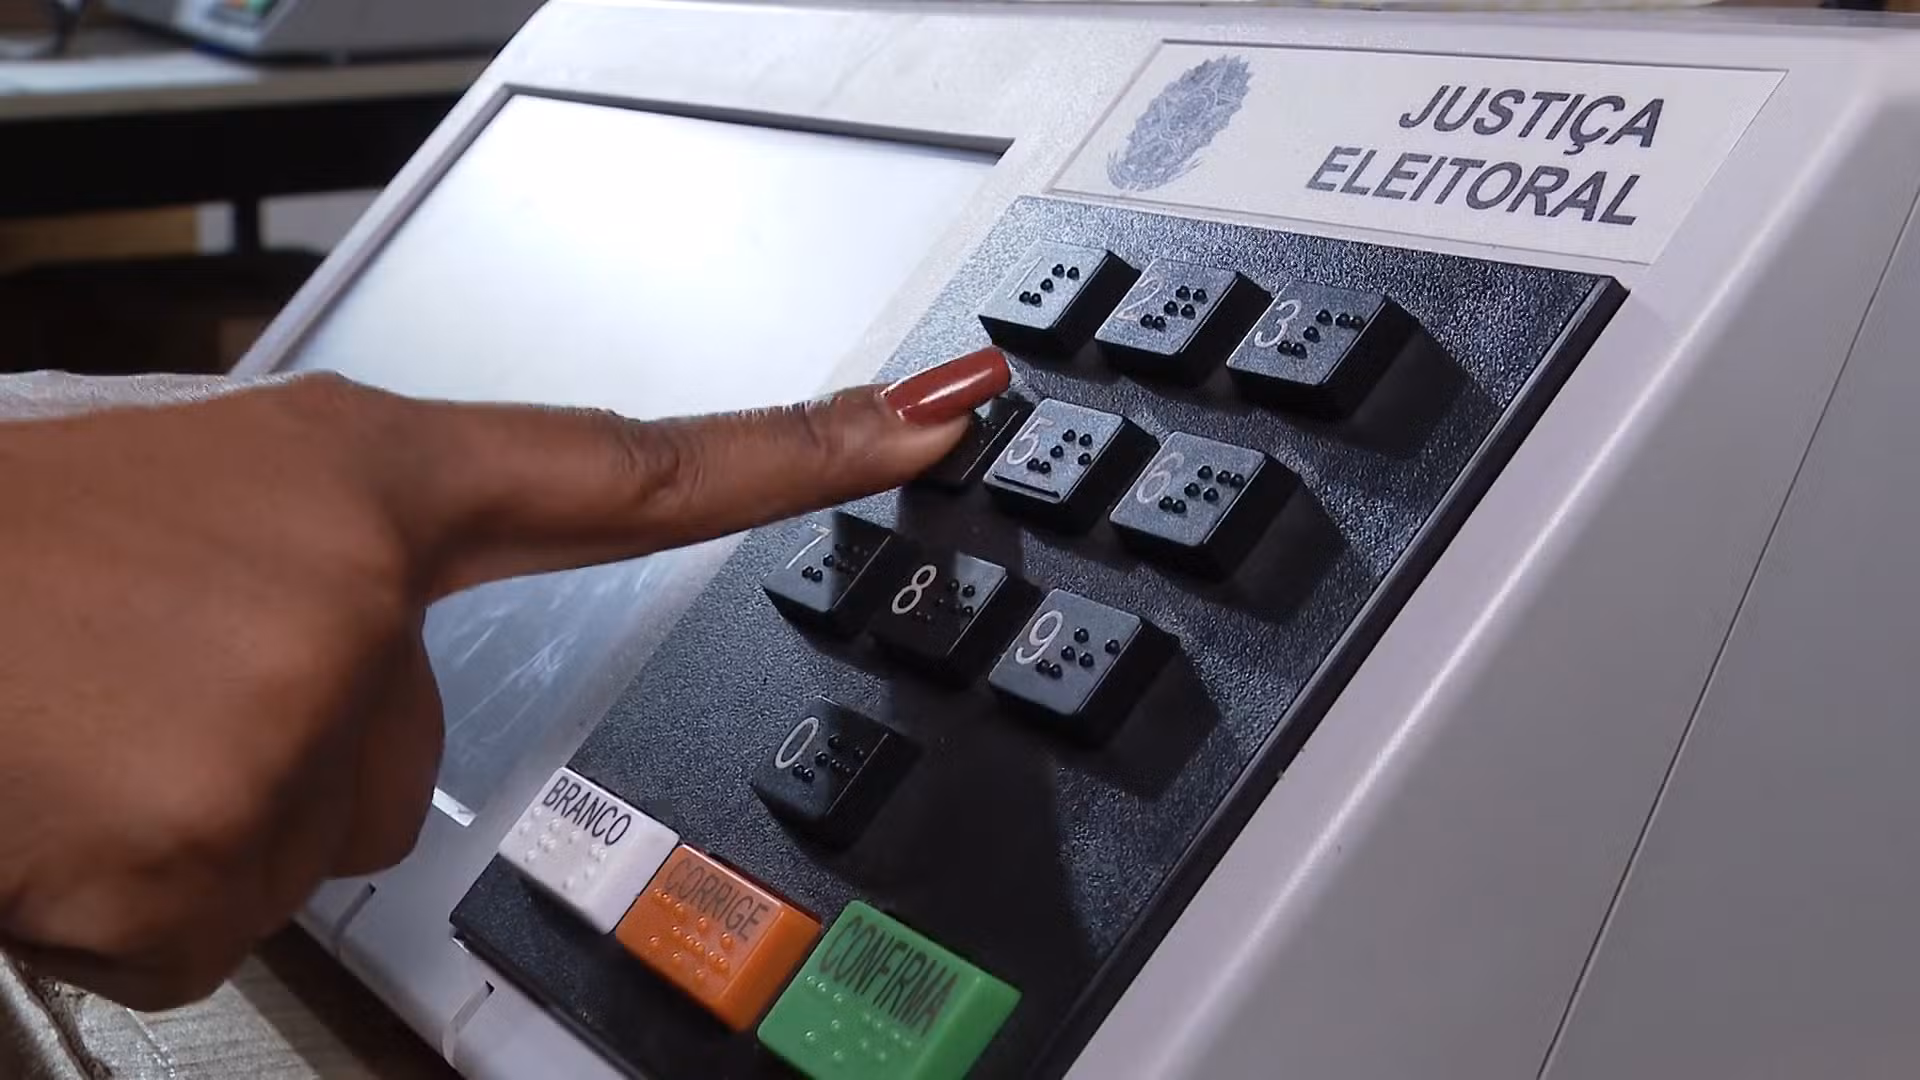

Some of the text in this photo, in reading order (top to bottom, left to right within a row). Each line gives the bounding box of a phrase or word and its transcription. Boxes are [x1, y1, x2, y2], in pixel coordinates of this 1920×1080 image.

[1399, 84, 1665, 154] JUSTIÇA
[1306, 146, 1640, 226] ELEITORAL
[1007, 256, 1043, 300] 1
[1115, 273, 1161, 321] 2
[1254, 301, 1298, 348] 3
[1005, 418, 1054, 465] 5
[1136, 453, 1184, 503] 6
[785, 524, 832, 569] 7
[892, 565, 937, 614] 8
[1015, 610, 1064, 665] 9
[775, 716, 819, 769] 0
[542, 776, 632, 846] BRANCO
[663, 857, 769, 942] CORRIGE
[819, 915, 960, 1037] CONFIRMA
